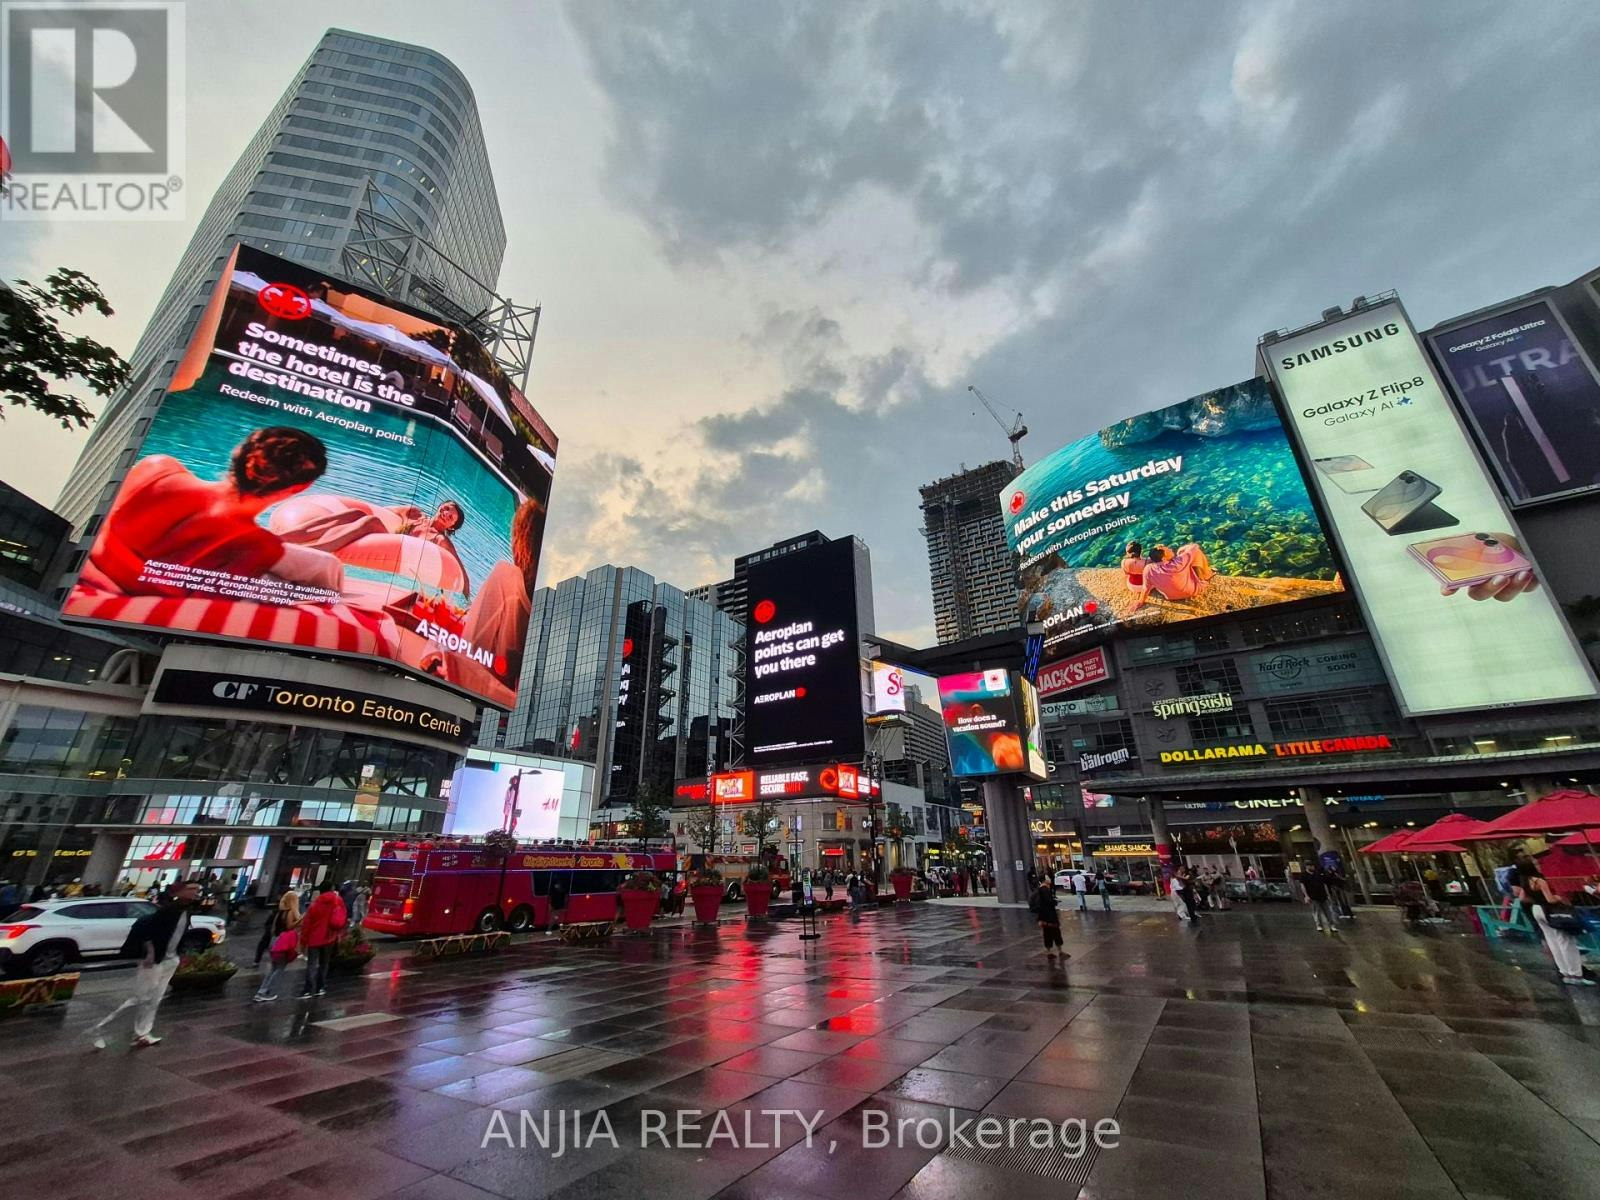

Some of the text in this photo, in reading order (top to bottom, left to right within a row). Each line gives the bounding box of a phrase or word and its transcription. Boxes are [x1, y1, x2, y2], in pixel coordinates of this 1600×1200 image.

[1281, 323, 1400, 370] SAMSUNG
[1449, 338, 1484, 353] Galaxy
[1520, 319, 1546, 331] Ultra
[245, 322, 386, 381] Sometimes,
[229, 361, 371, 413] destination
[238, 340, 415, 407] the hotel is the
[1302, 376, 1424, 418] Galaxy Z Flip8
[219, 383, 416, 447] Redeem with Aeroplan points.
[1324, 401, 1394, 427] Galaxy AI
[1014, 456, 1183, 537] Make this Saturday
[1016, 491, 1131, 556] your someday
[1046, 542, 1063, 556] with
[1063, 524, 1103, 547] Aeroplan
[1105, 514, 1140, 531] points.
[137, 574, 146, 582] a
[147, 576, 184, 588] reward
[185, 580, 217, 594] varies.
[219, 586, 268, 602] Conditions
[143, 566, 163, 576] The
[164, 570, 202, 583] number
[204, 575, 217, 585] of
[217, 576, 260, 592] Aeroplan
[260, 585, 288, 598] points
[289, 590, 327, 604] required
[145, 559, 190, 573] Aeroplan
[192, 567, 231, 580] rewards
[232, 574, 248, 583] are
[249, 577, 282, 590] subject
[284, 582, 293, 590] to
[415, 618, 494, 669] AEROPLAN
[754, 629, 845, 663] points can get
[755, 621, 812, 645] Aeroplan
[754, 654, 816, 679] you there
[1259, 657, 1310, 672] Hard Rock
[1316, 652, 1358, 664] COMING
[1327, 662, 1356, 672] SOON
[1037, 662, 1085, 693] JACK'S
[212, 680, 461, 738] CF Toronto Eaton Centre
[754, 689, 796, 704] AEROPLAN
[980, 719, 1006, 729] sound?
[1080, 748, 1129, 771] ballroom
[1160, 744, 1267, 763] DOLLARAMA
[760, 772, 791, 785] RELIABLE
[760, 783, 786, 795] SECURE
[1234, 796, 1340, 810] CINEPLX
[1030, 820, 1054, 833] ACK
[1104, 844, 1153, 852] SHAKE SHACK
